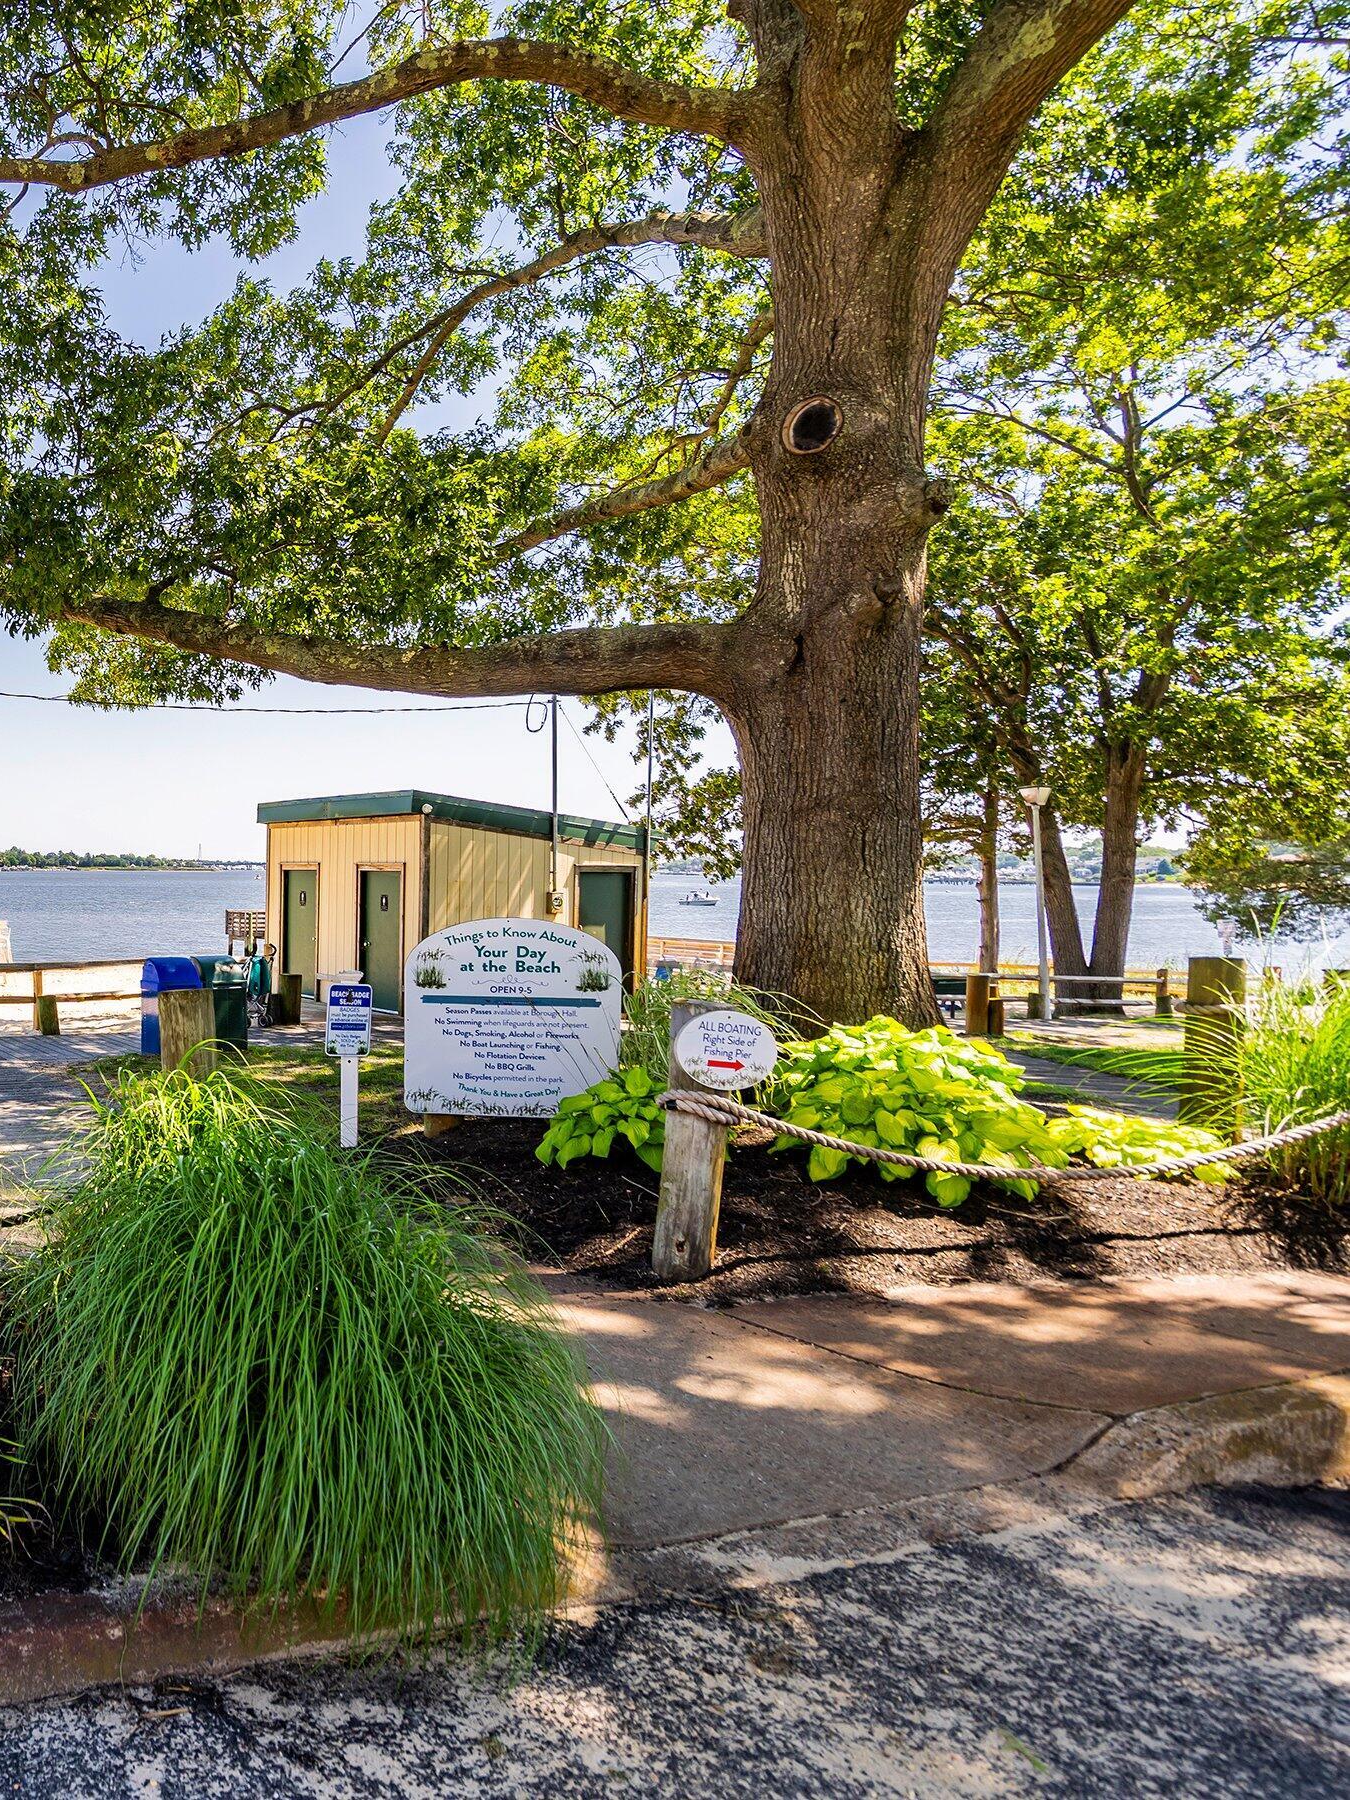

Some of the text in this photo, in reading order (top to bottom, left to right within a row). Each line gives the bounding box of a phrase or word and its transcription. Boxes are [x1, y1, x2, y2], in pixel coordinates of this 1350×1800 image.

[444, 927, 578, 948] Things to Know About
[474, 945, 547, 963] Your Day
[460, 960, 561, 973] at the Beach
[490, 986, 532, 994] OPEN 9-5
[445, 1007, 469, 1015] Season
[446, 1018, 482, 1028] Swimming
[502, 1019, 535, 1029] lifeguards
[698, 1021, 762, 1037] ALL BOATING
[454, 1029, 474, 1038] Dogs,
[475, 1030, 507, 1039] Smoking,
[702, 1033, 757, 1047] Right Side of
[489, 1041, 525, 1051] Launching
[486, 1052, 518, 1060] Flotation
[703, 1046, 752, 1060] Fishing Pier
[497, 1063, 515, 1072] BBQ
[465, 1073, 492, 1082] Bicycles
[493, 1074, 526, 1084] permitted
[458, 1083, 478, 1094] Thank
[479, 1087, 492, 1096] You
[493, 1089, 499, 1097] &
[500, 1090, 518, 1098] Have
[524, 1090, 543, 1098] Great
[545, 1087, 561, 1096] Day!
